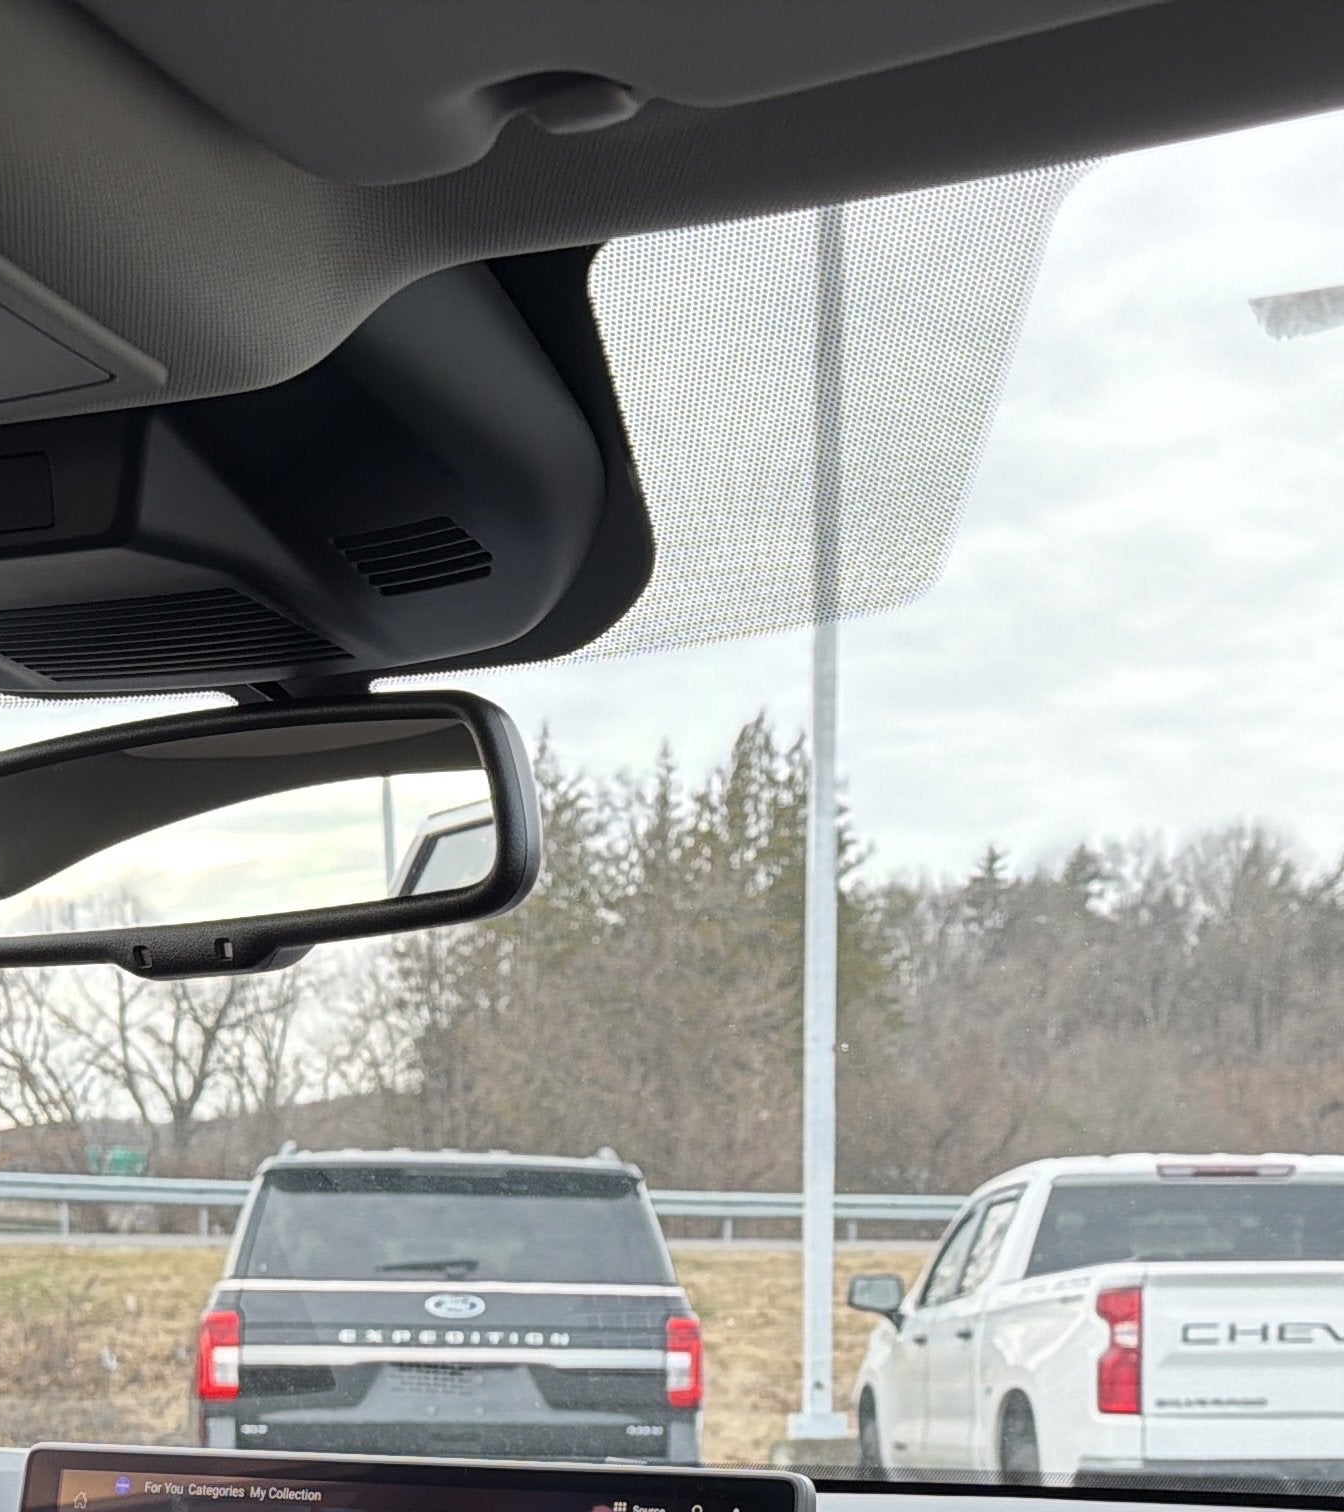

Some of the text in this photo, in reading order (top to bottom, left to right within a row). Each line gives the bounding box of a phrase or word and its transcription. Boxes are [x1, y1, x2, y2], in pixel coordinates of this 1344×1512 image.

[337, 1328, 571, 1346] EXPEDITION
[144, 1481, 322, 1502] For You Categories My Collection
